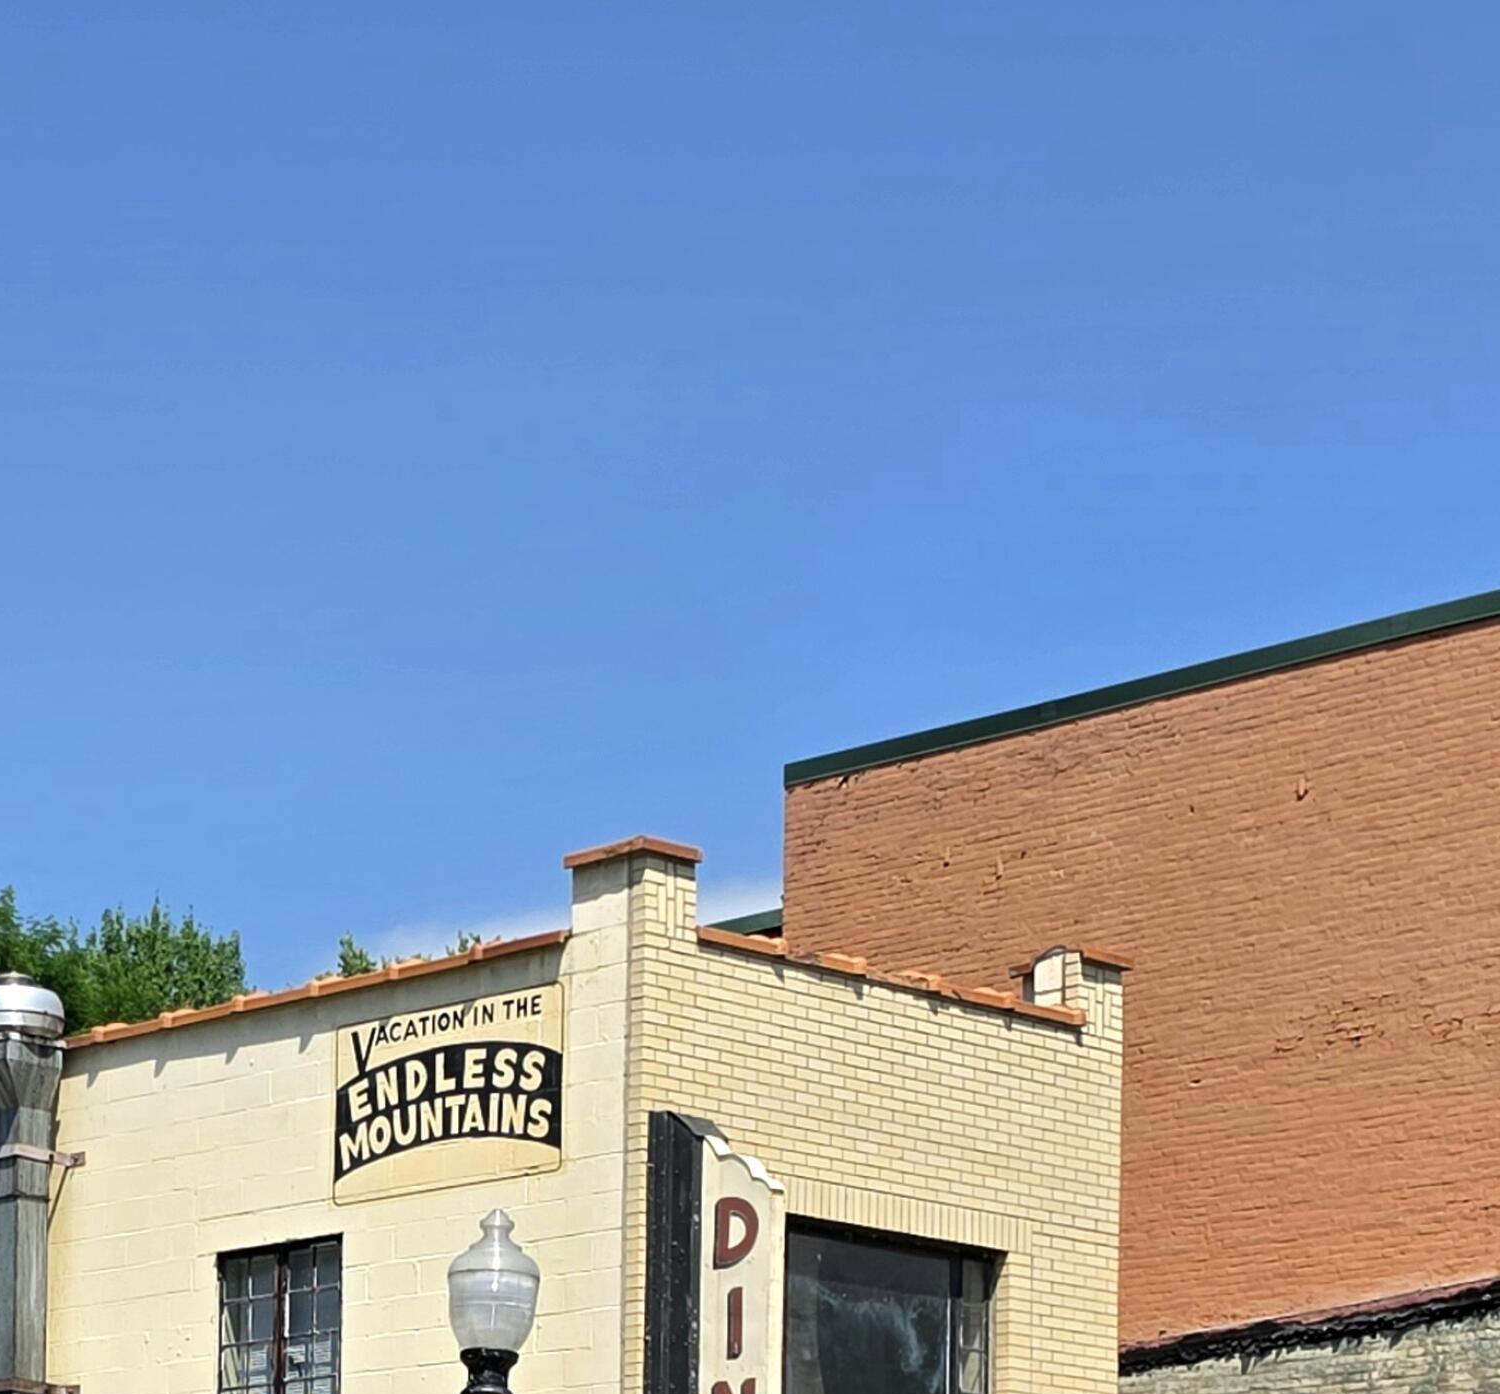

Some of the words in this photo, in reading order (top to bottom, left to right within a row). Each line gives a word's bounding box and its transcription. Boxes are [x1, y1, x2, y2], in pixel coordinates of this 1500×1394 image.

[351, 1011, 464, 1074] VACATION
[473, 1003, 494, 1026] IN
[503, 995, 542, 1021] THE
[348, 1048, 546, 1122] ENDLESS
[339, 1093, 552, 1171] MOUNTAINS
